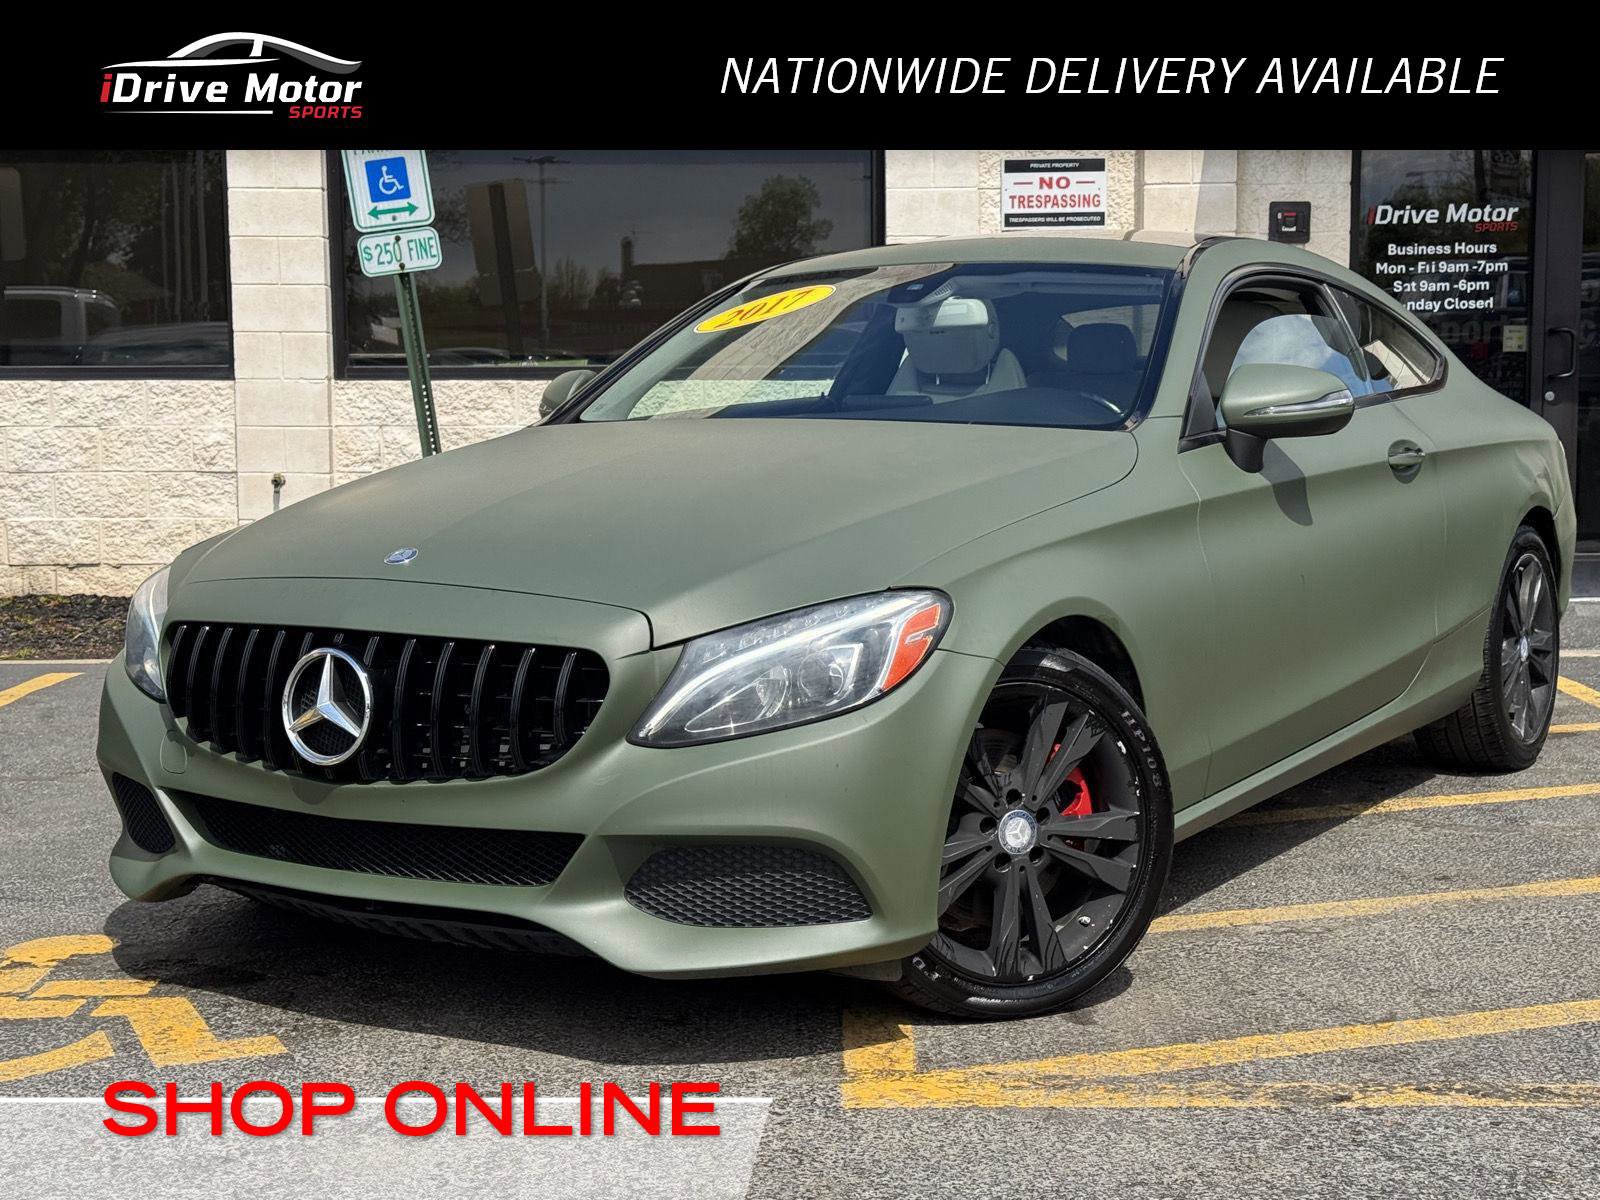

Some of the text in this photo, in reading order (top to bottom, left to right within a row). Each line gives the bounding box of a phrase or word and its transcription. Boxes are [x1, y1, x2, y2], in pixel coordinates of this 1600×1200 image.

[1038, 176, 1071, 190] NO
[1008, 194, 1101, 209] TRESPASSING
[1367, 203, 1519, 225] iDrive Motor
[1474, 221, 1518, 232] SPORTS
[407, 236, 437, 261] FINE
[1387, 242, 1497, 256] Business Hours
[1376, 262, 1406, 275] Mon
[1438, 261, 1469, 273] 9am
[1419, 280, 1450, 292] 9am
[714, 289, 814, 328] 2017
[1444, 297, 1493, 310] Closed
